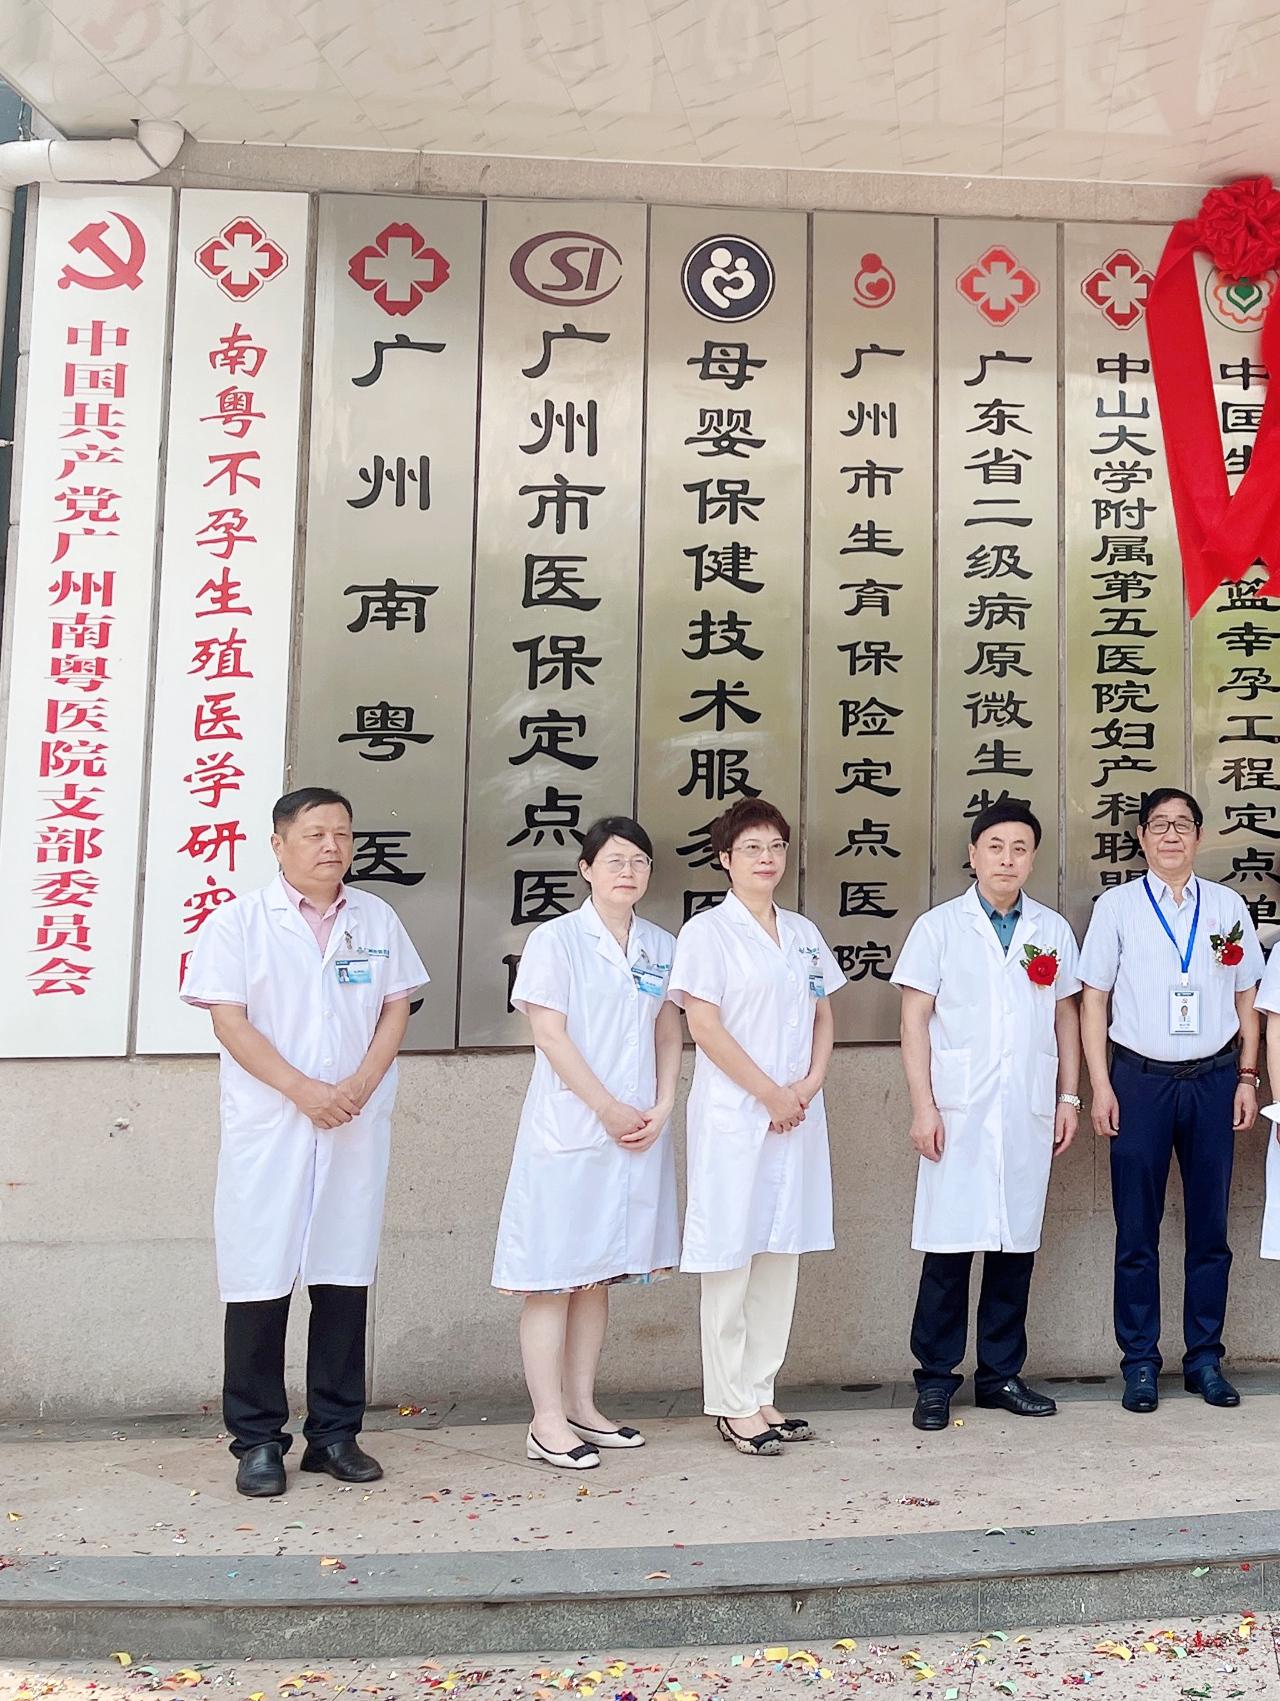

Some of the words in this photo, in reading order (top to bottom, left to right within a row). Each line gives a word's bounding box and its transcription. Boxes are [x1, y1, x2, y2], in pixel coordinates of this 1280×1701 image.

[25, 320, 130, 997] 中国共产党广州南粤医院支部委员会
[178, 323, 268, 993] 南粤不孕生殖医学研究
[337, 334, 447, 1015] 广州南粤医
[502, 324, 611, 1014] 广州市医保定点医
[833, 344, 905, 982] 广州市生育保险定点医院
